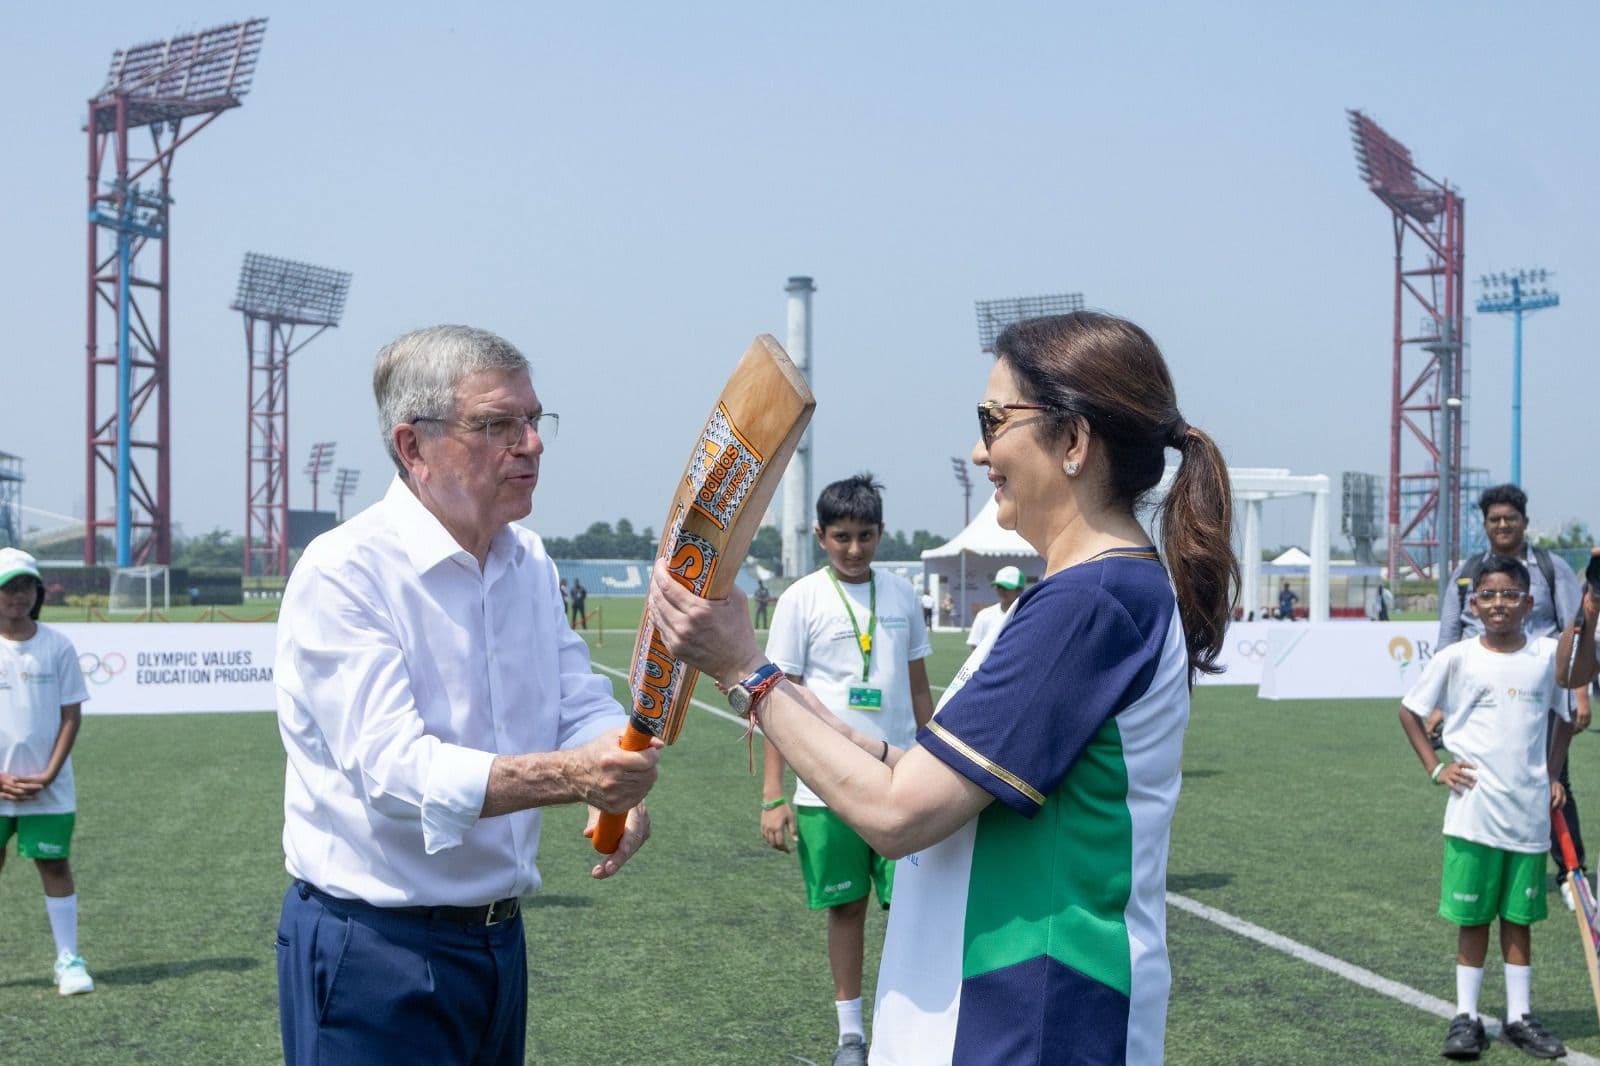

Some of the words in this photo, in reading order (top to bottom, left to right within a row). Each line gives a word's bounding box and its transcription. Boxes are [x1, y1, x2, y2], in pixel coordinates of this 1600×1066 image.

[699, 444, 740, 502] adidas
[137, 651, 198, 667] OLYMPIC
[202, 650, 252, 666] VALUES
[136, 668, 211, 685] EDUCATION
